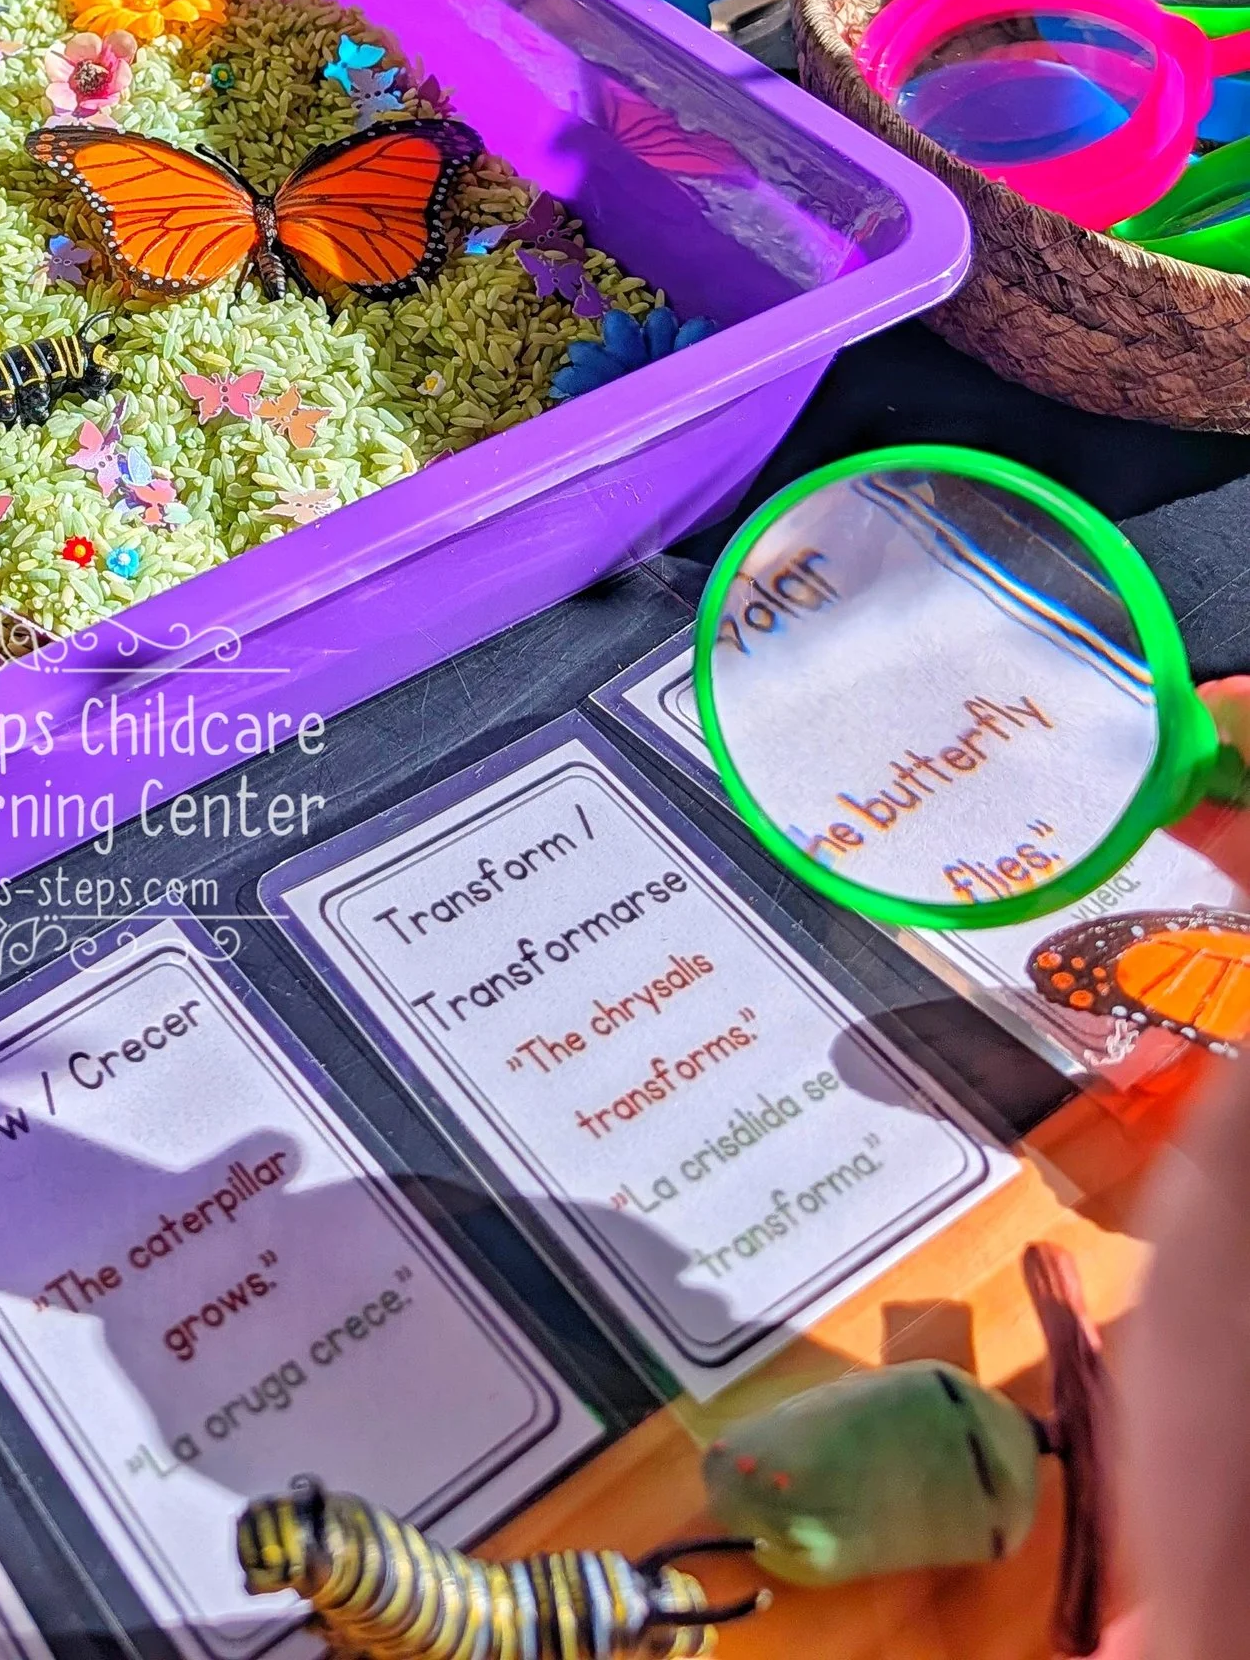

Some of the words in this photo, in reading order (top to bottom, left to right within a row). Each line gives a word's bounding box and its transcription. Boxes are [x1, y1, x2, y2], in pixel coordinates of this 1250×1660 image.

[837, 694, 1054, 831] butterfly
[375, 828, 577, 946] Transform
[574, 803, 595, 840] /
[413, 869, 688, 1032] Transformarse
[590, 953, 714, 1036] chrysalis
[41, 1071, 59, 1115] /
[67, 996, 203, 1090] Crecer
[679, 1092, 803, 1182] crisálida
[802, 1070, 840, 1102] se
[128, 1151, 287, 1270] caterpillar
[204, 1359, 307, 1440] oruga
